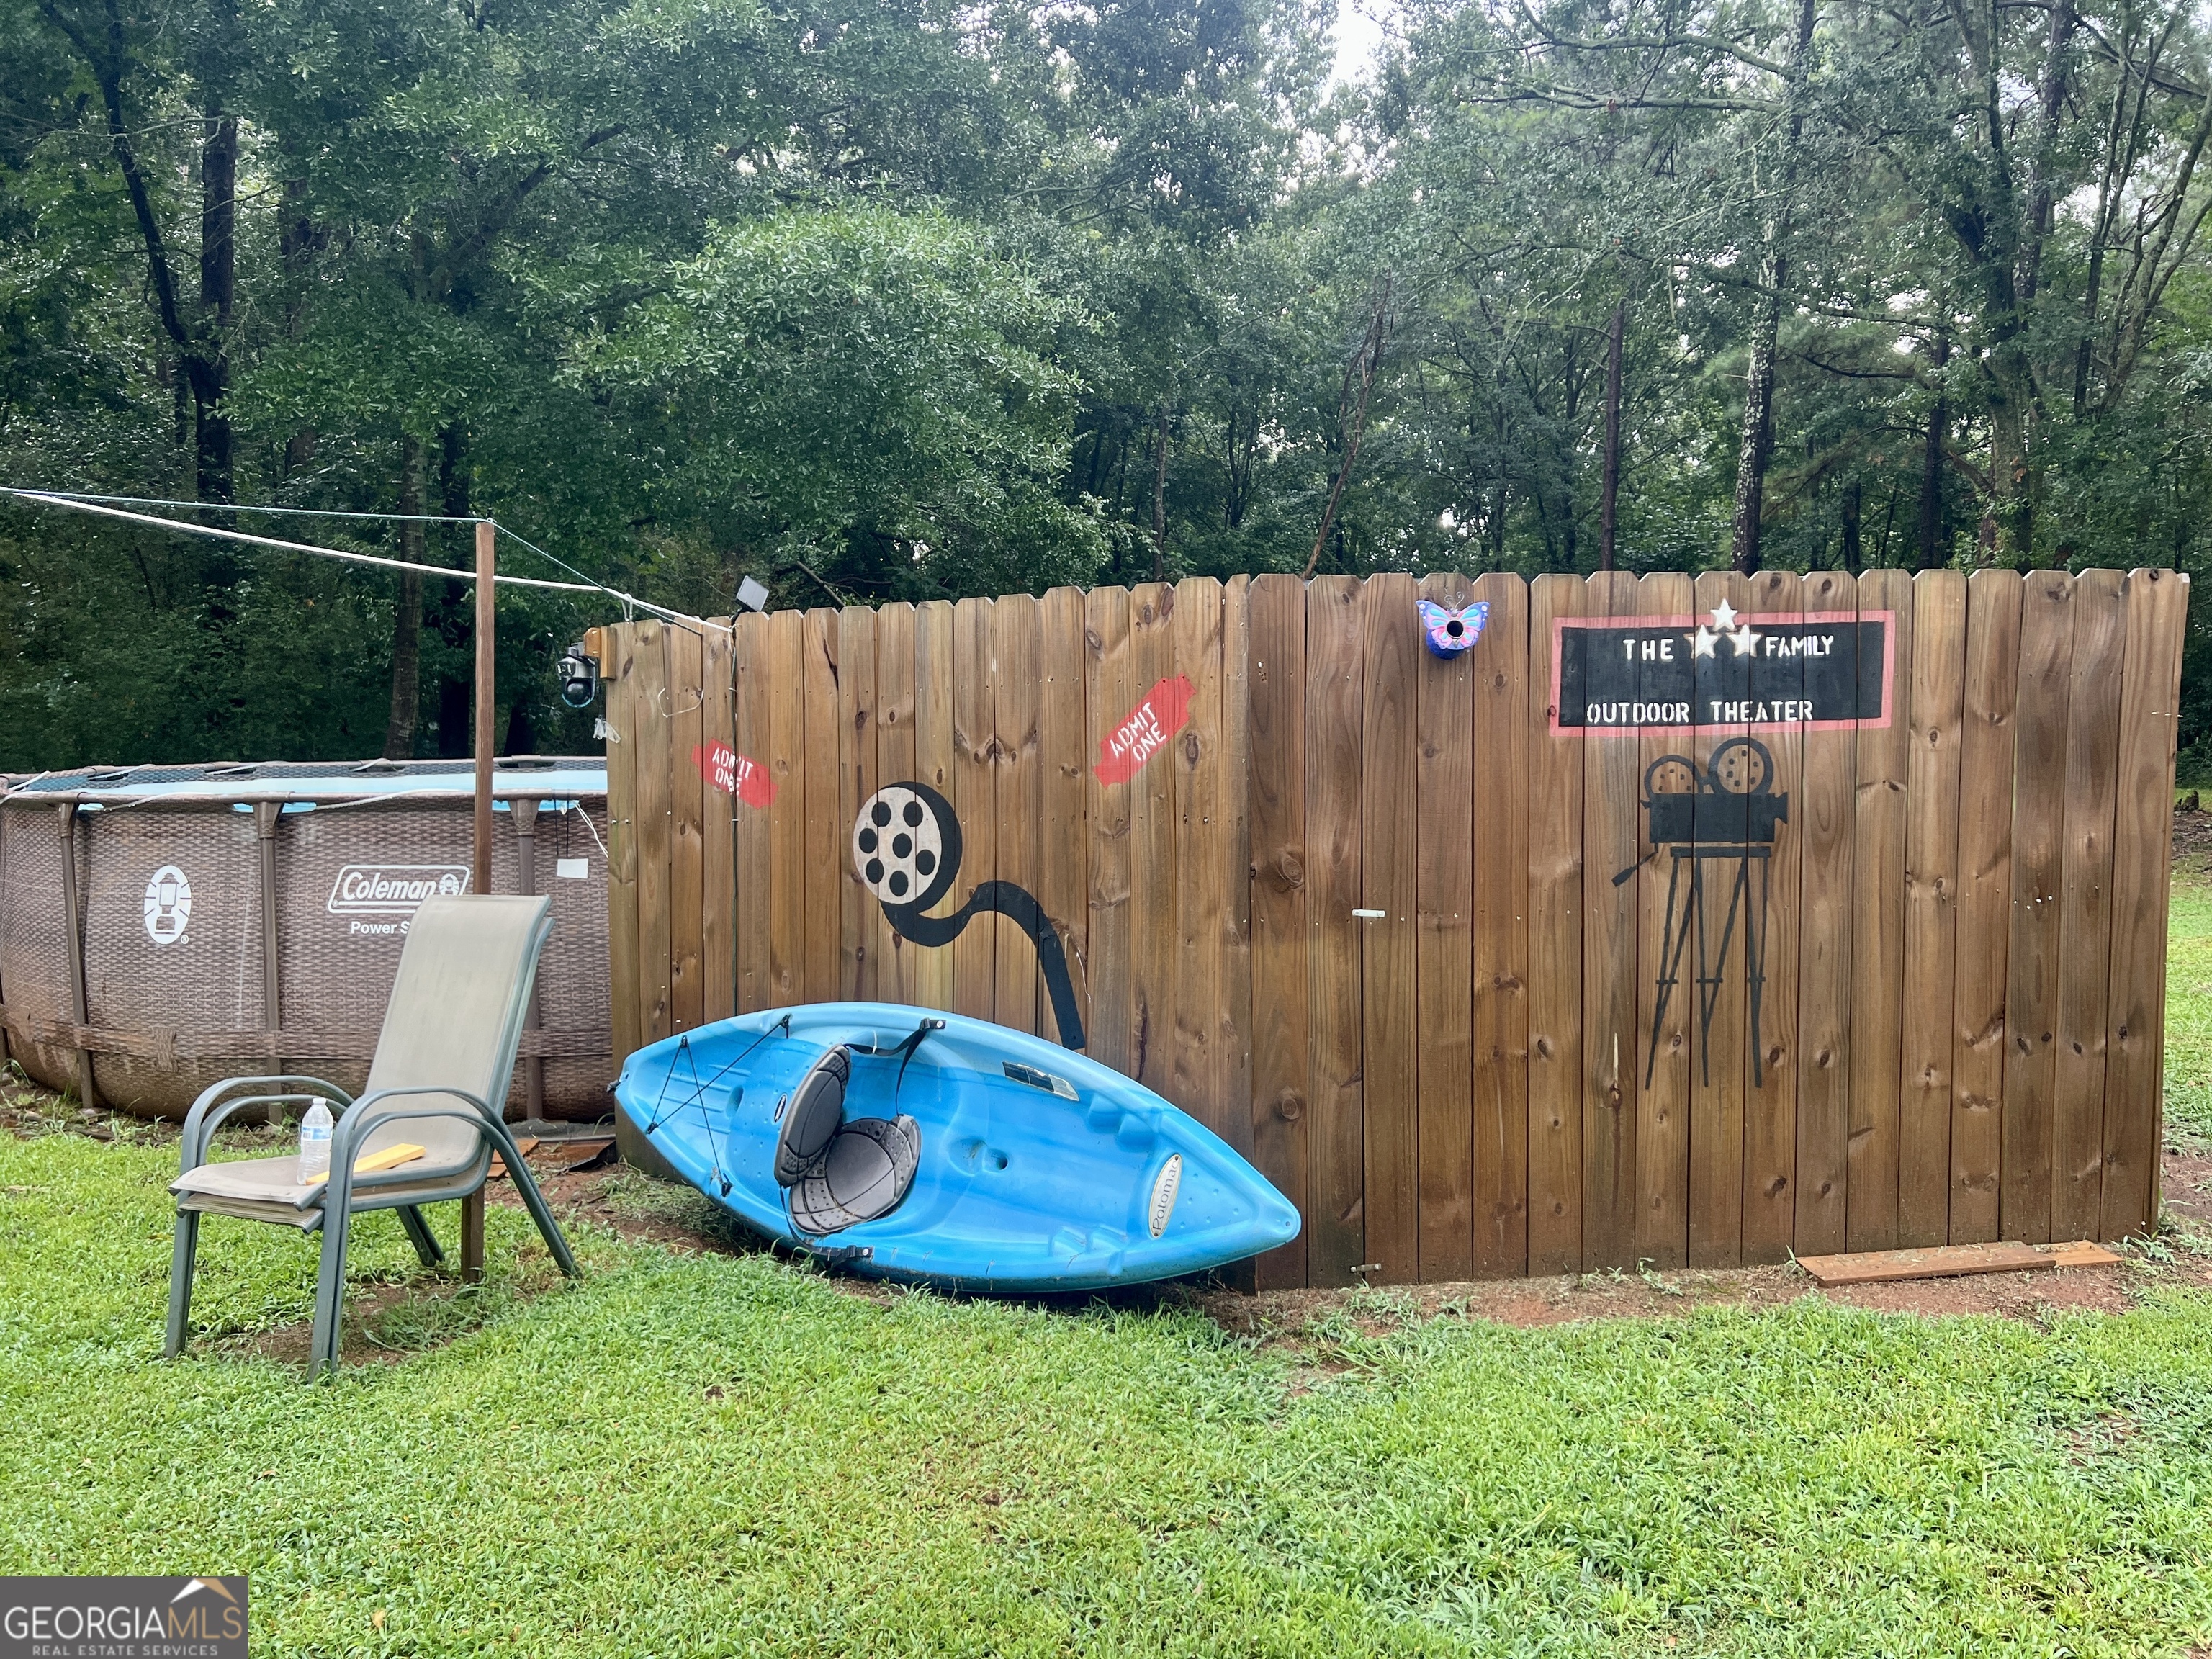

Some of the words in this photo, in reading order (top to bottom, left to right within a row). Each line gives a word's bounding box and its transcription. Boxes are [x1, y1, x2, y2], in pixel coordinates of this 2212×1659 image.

[1623, 638, 1675, 661] THE
[1764, 634, 1835, 658] FAMILY
[1586, 701, 1690, 724] OUTDOOR
[1709, 699, 1814, 723] THEATER
[1110, 701, 1156, 758] ADMIT
[1133, 721, 1167, 762] ONE
[711, 747, 754, 778] ADMIT
[342, 871, 437, 900] Coleman
[351, 921, 397, 935] Power
[1152, 1160, 1179, 1231] Potomac
